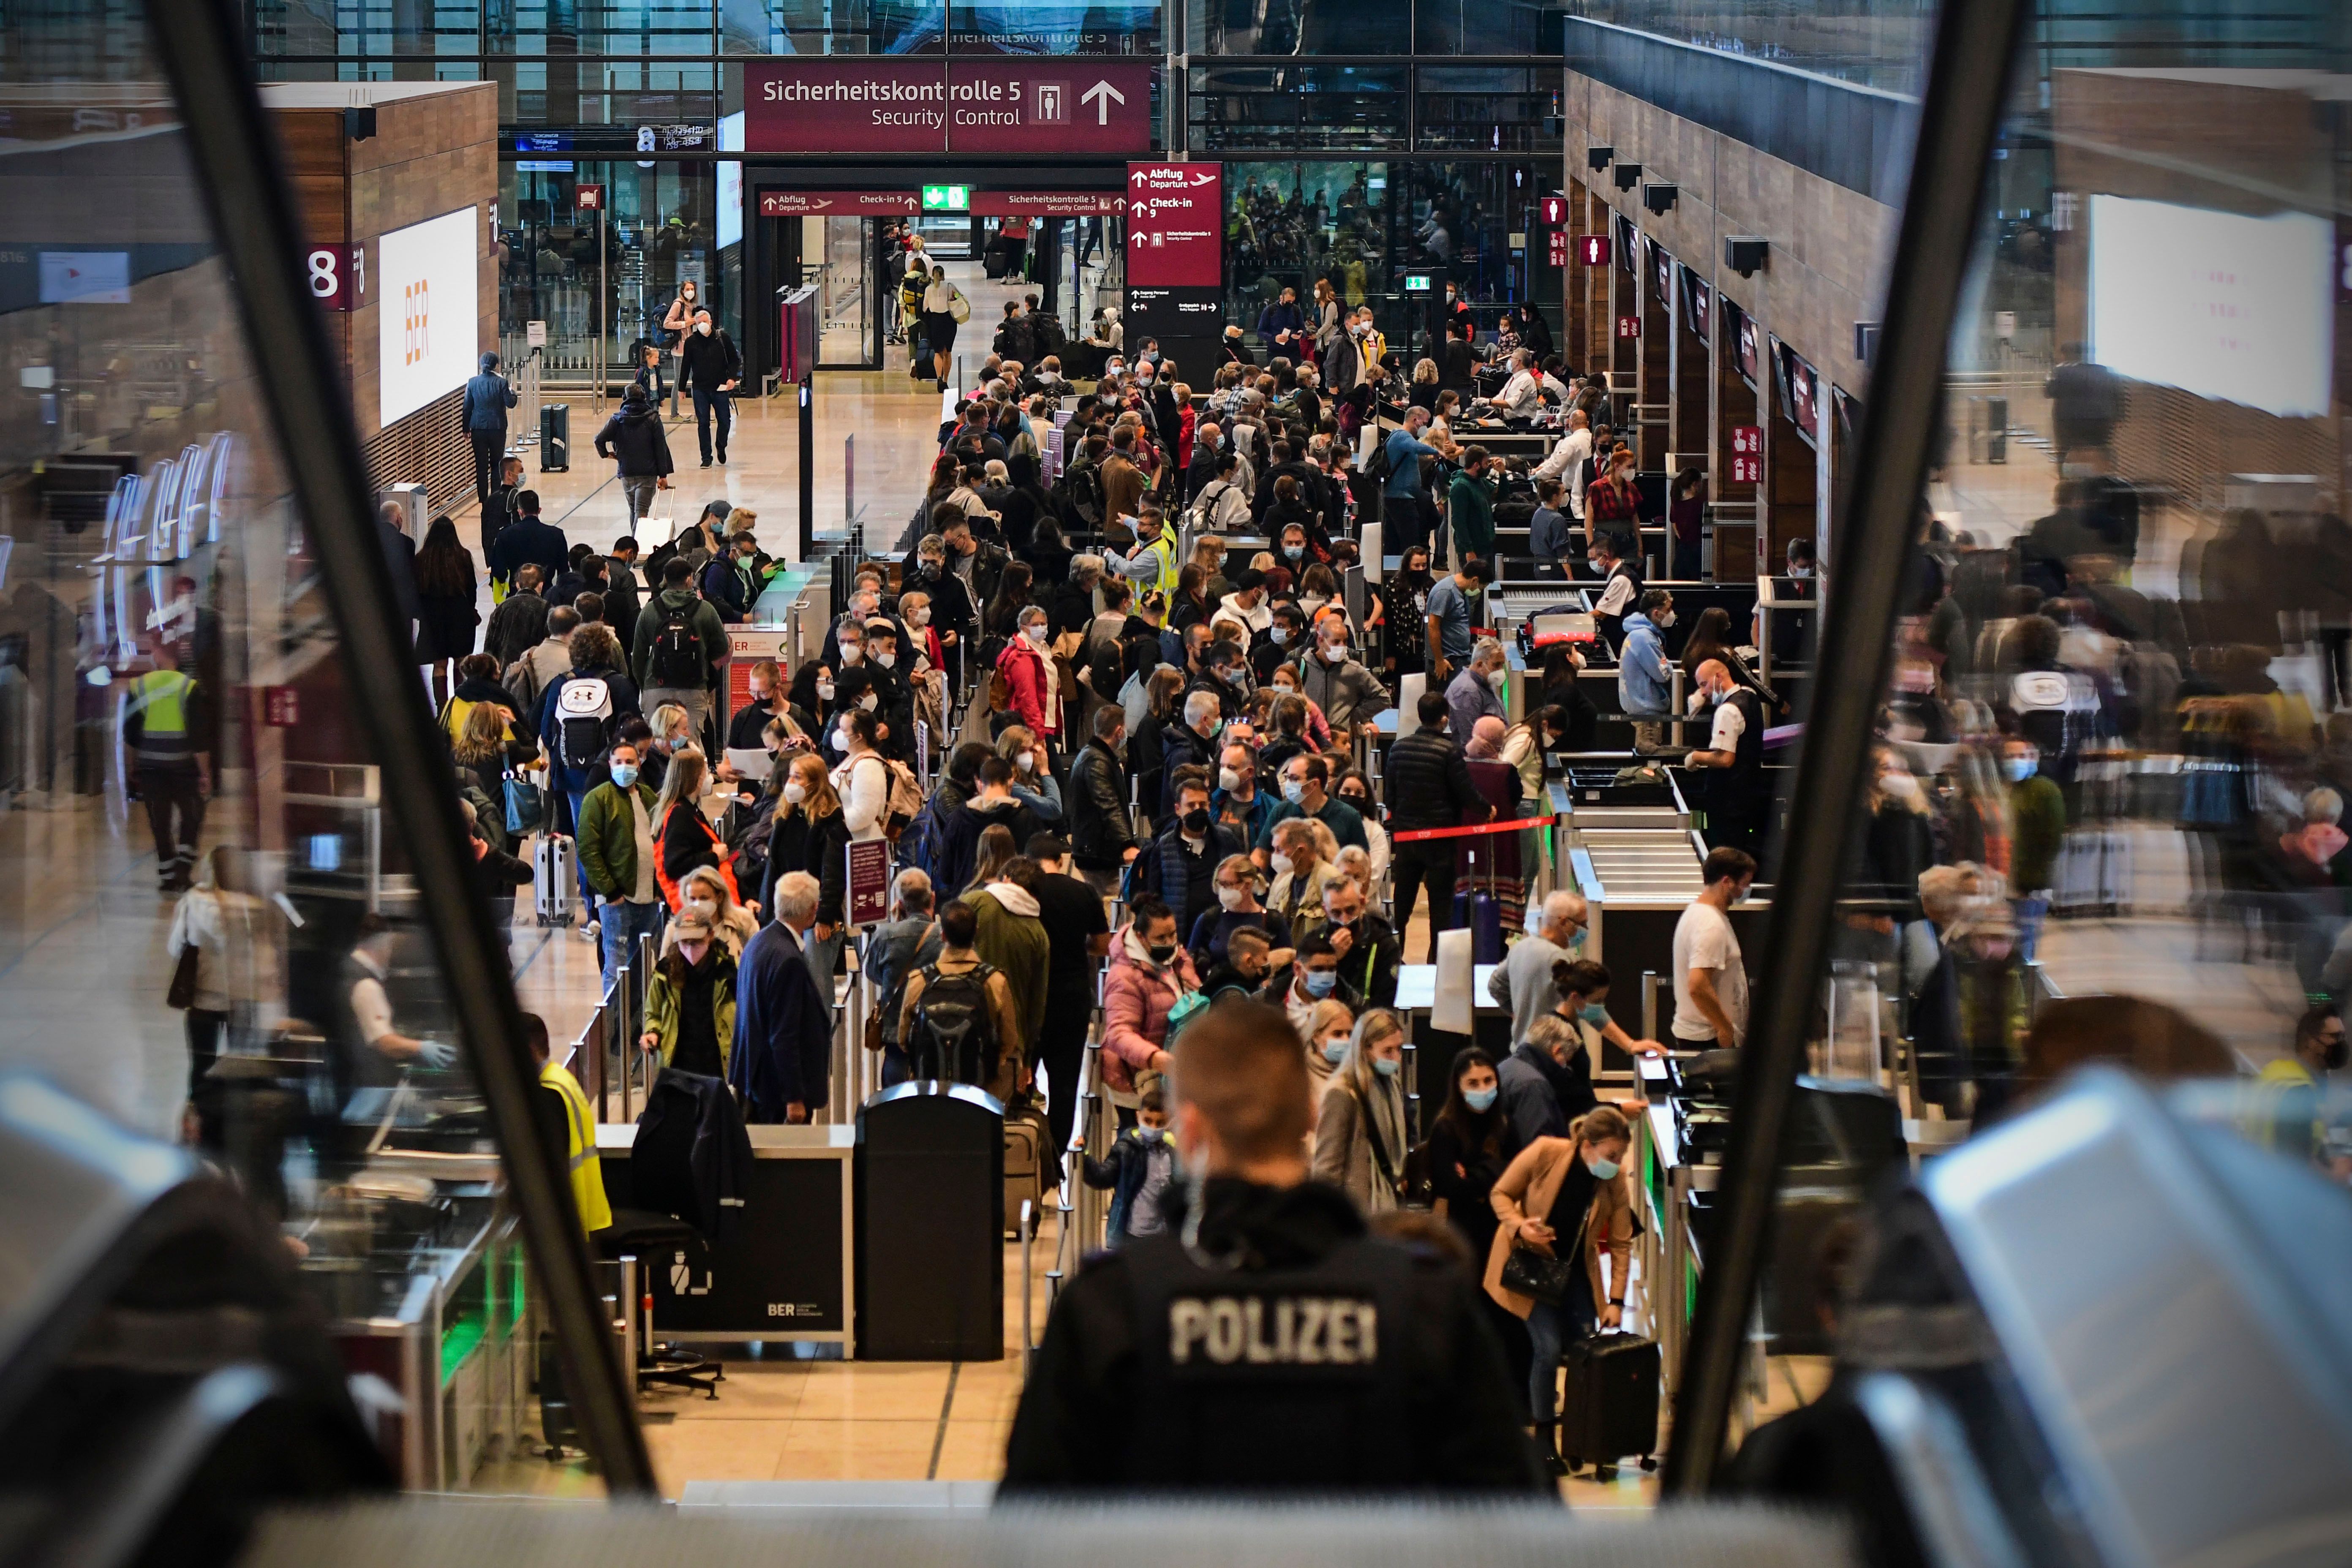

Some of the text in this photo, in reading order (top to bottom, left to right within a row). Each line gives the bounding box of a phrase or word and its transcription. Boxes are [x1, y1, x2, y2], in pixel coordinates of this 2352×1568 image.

[1009, 81, 1021, 101] 5
[871, 108, 1020, 130] Security Control
[1149, 169, 1183, 181] Abflug
[1150, 180, 1188, 190] Departure
[779, 195, 806, 204] Abflug
[1009, 195, 1089, 203] Sicherheitskontrolle
[1149, 197, 1192, 207] Check-in
[1149, 209, 1157, 218] 9
[493, 203, 498, 243] 8
[308, 250, 338, 297] 8
[359, 248, 365, 294] 8
[406, 279, 429, 366] BER
[735, 642, 748, 651] ER
[768, 1304, 795, 1316] BER
[1171, 1299, 1377, 1363] POLIZEI
